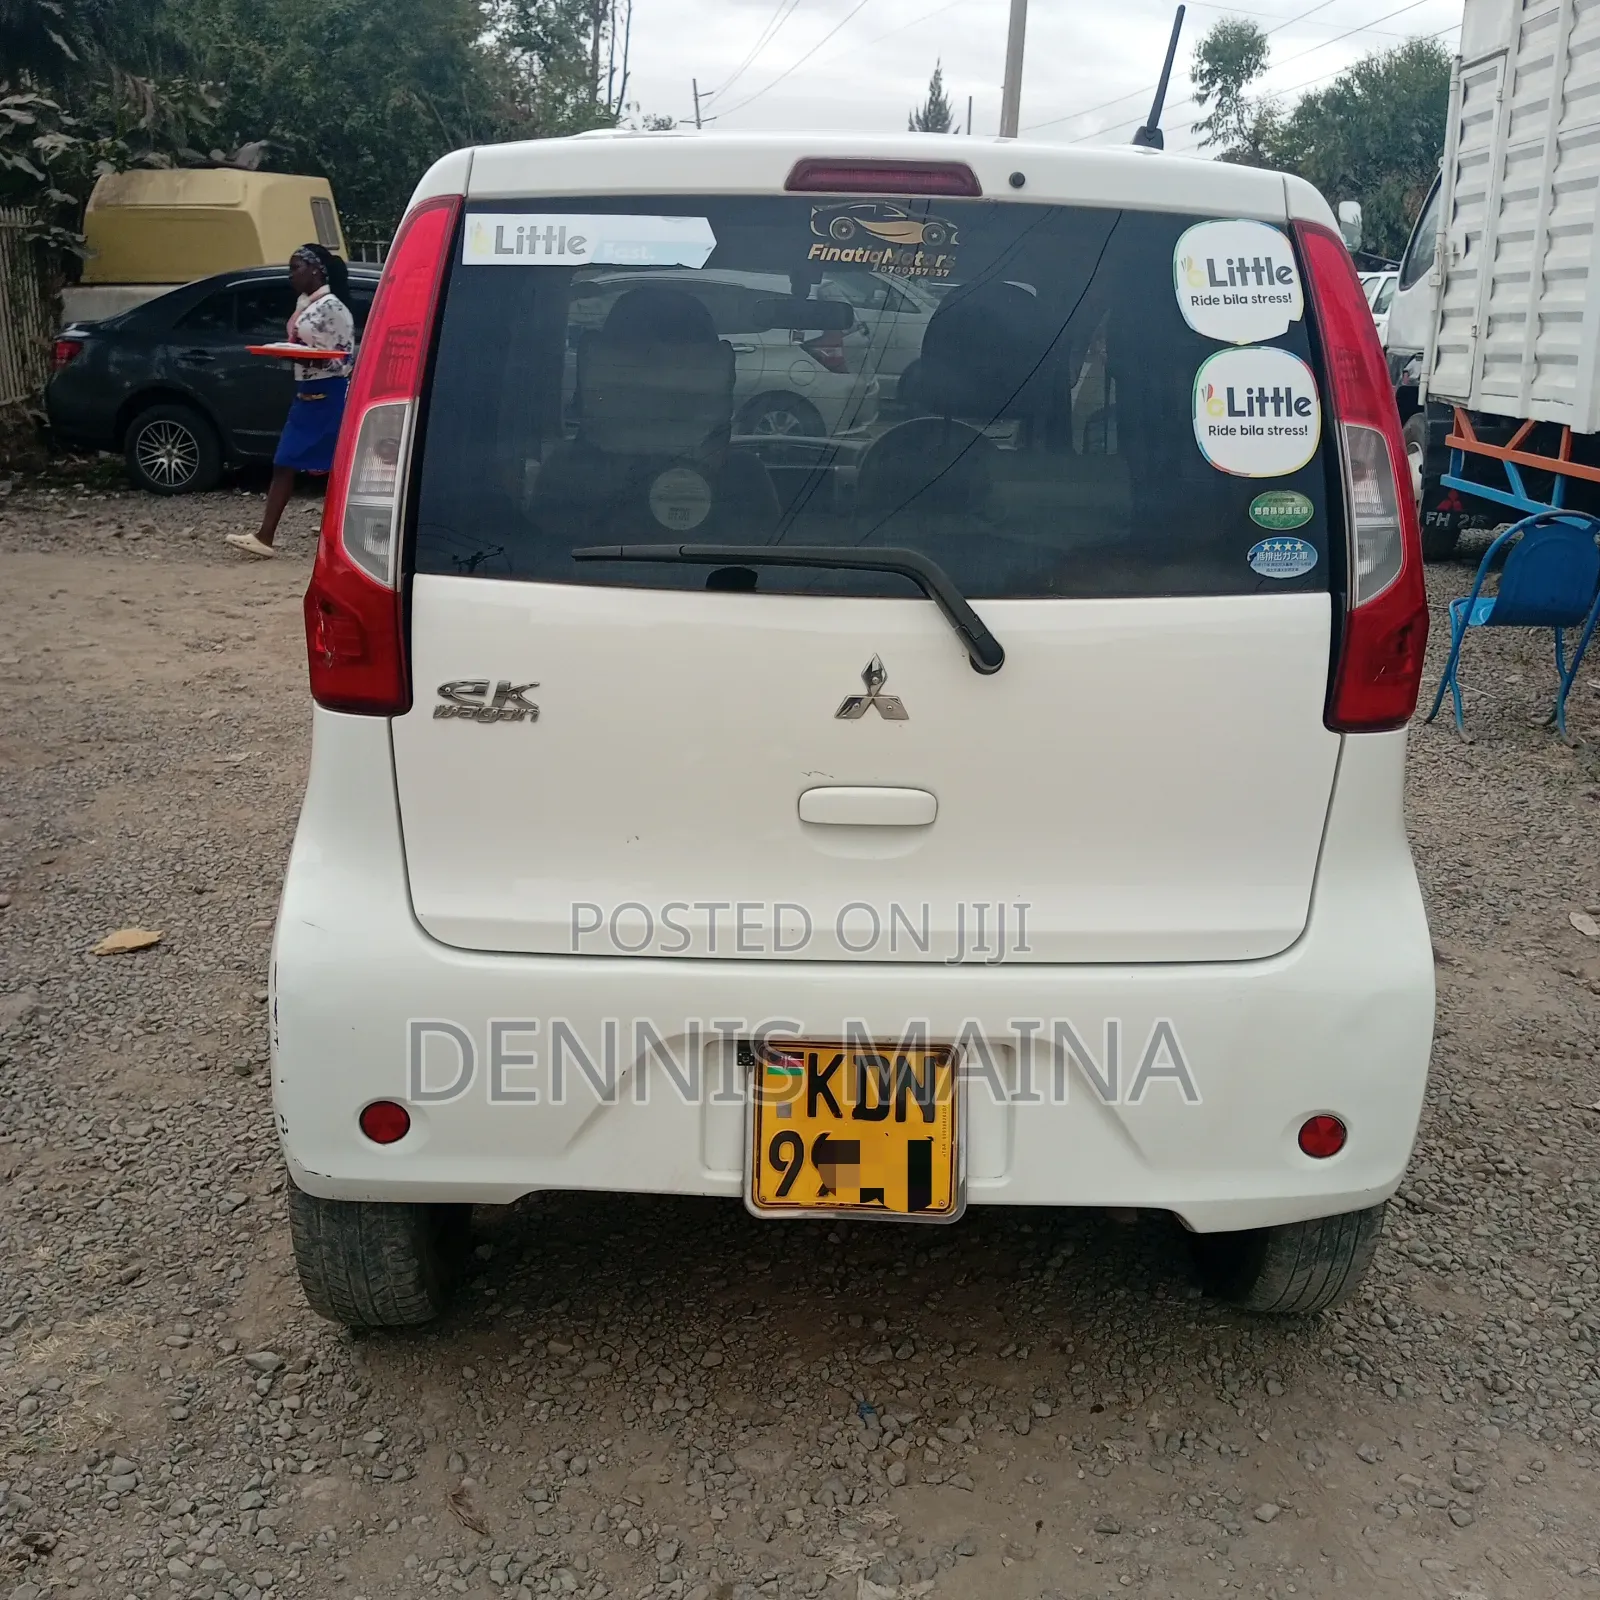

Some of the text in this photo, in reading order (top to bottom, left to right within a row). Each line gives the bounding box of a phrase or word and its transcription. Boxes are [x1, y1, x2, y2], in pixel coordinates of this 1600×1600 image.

[494, 225, 587, 255] Little
[1206, 256, 1294, 288] Little
[1191, 293, 1292, 306] Ride bila stress!
[1226, 387, 1312, 417] Little
[1208, 425, 1308, 436] Ride bila stress!
[1425, 511, 1451, 527] FH
[806, 1052, 936, 1123] KDN
